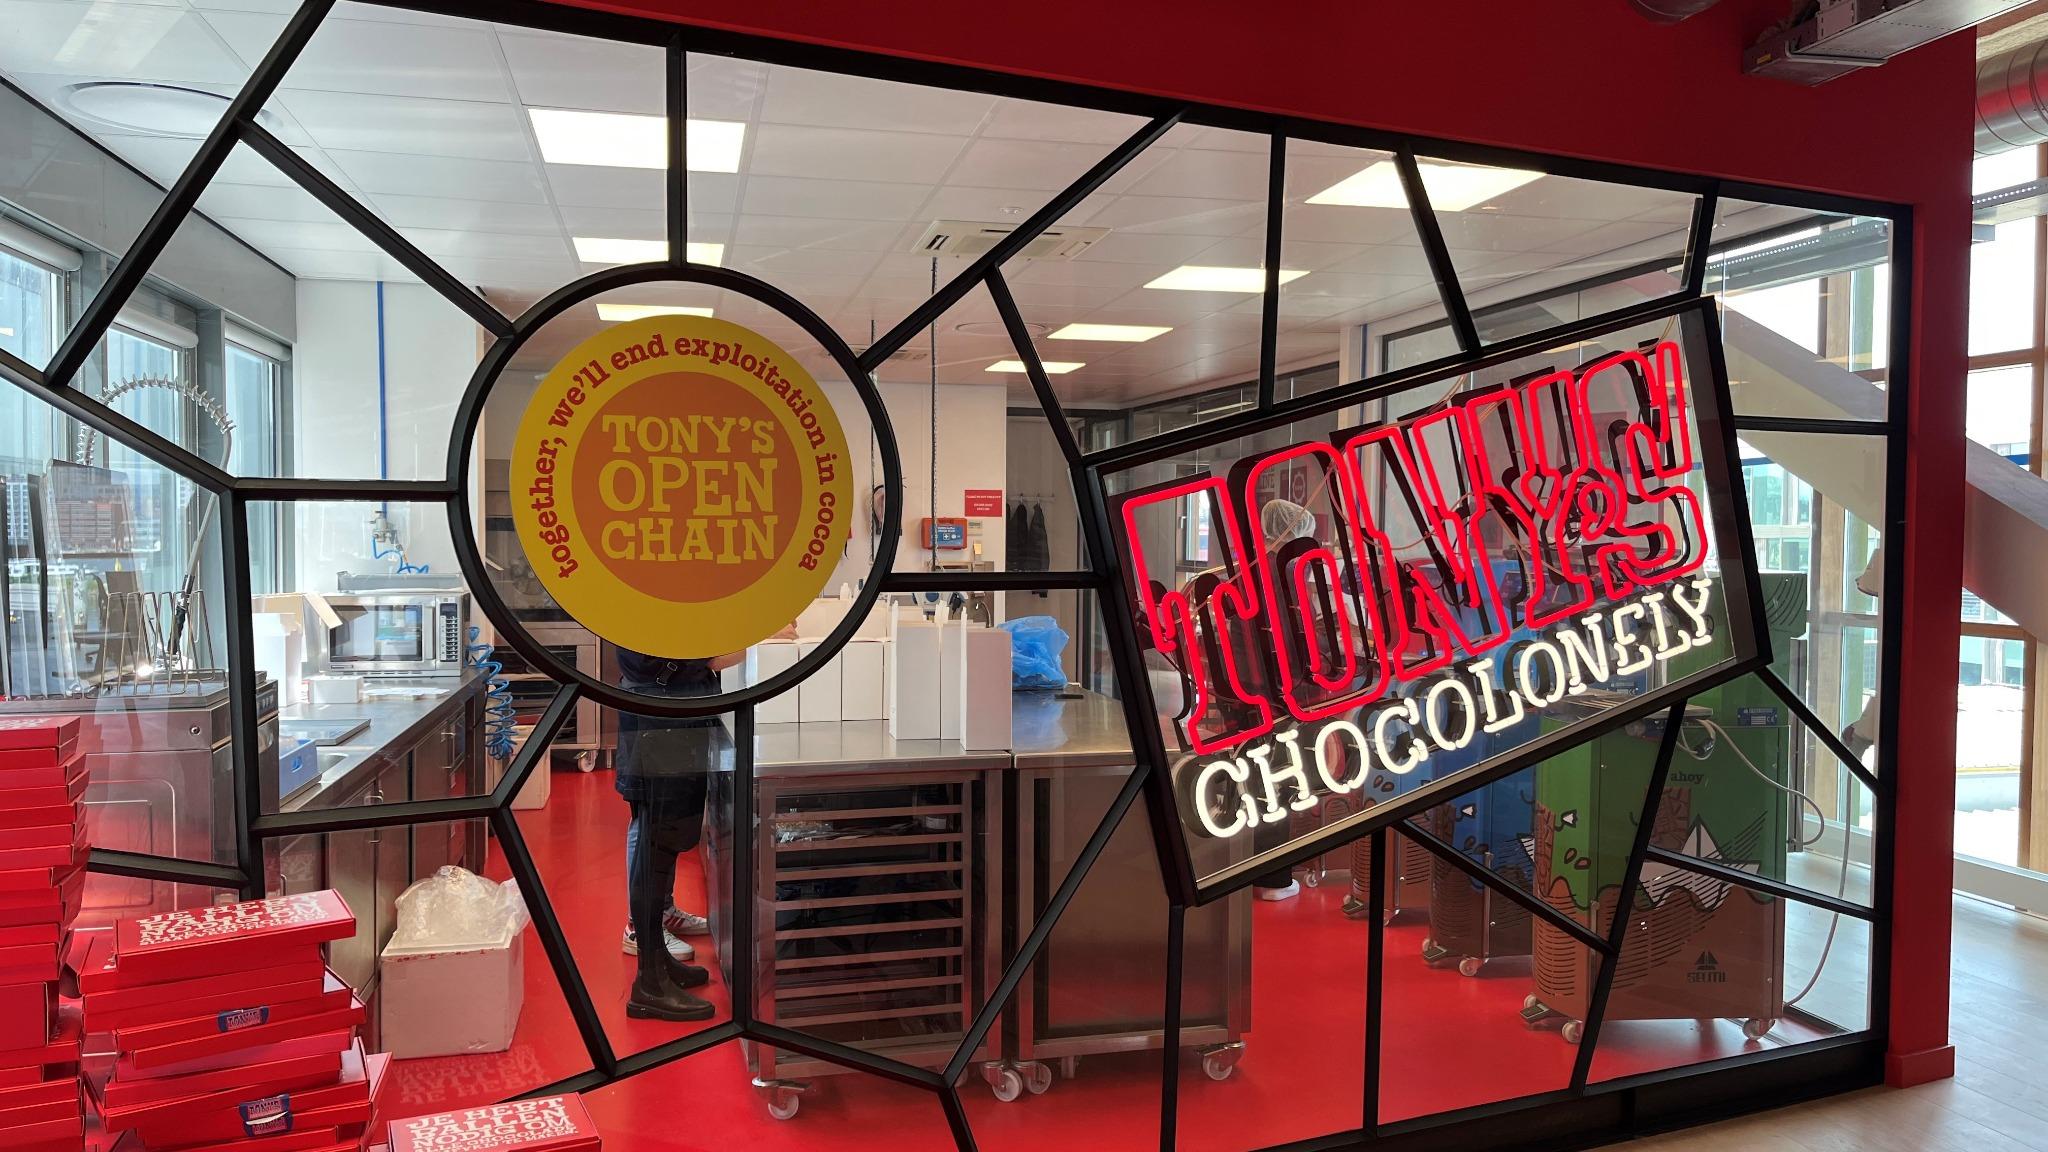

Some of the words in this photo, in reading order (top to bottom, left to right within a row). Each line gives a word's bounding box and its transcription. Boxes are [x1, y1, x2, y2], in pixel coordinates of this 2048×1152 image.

[610, 334, 668, 370] end
[548, 360, 611, 431] we'll
[674, 336, 827, 449] exploitation
[602, 415, 775, 454] TONY'S
[599, 456, 778, 516] OPEN
[815, 453, 838, 485] in
[529, 437, 579, 578] together,
[601, 515, 778, 564] CHAIN
[798, 491, 836, 572] cocoa
[1195, 578, 1712, 839] CHOCOLONELY
[1671, 771, 1704, 785] ahoy
[406, 1115, 455, 1129] JE
[464, 1098, 563, 1121] HEBT
[411, 1106, 566, 1140] BALLEN
[413, 1126, 516, 1149] NODIG
[525, 1116, 574, 1130] OM
